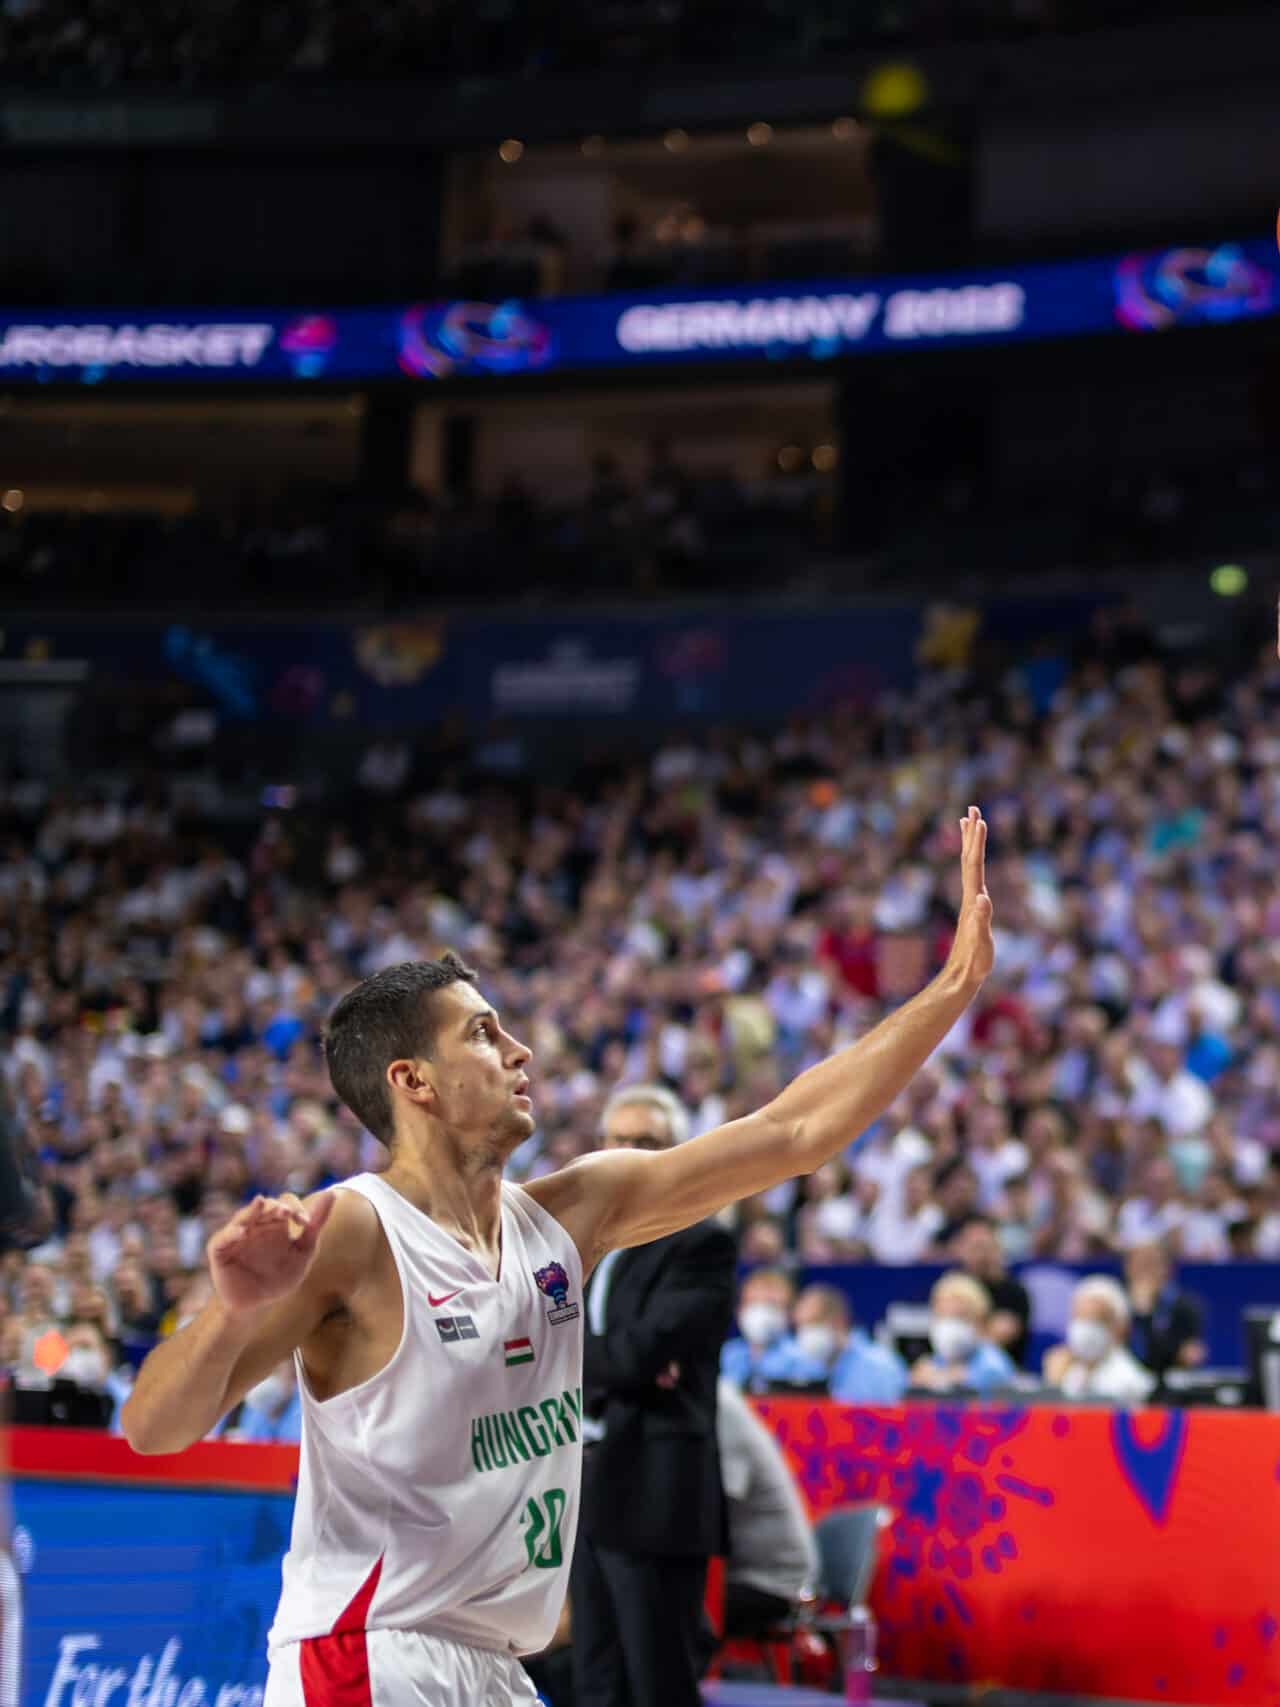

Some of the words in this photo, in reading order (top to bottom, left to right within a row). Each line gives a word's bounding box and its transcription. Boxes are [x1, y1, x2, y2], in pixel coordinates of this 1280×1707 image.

[0, 324, 273, 367] ROBASKET
[618, 294, 878, 352] GERMANY
[45, 1634, 128, 1707] For
